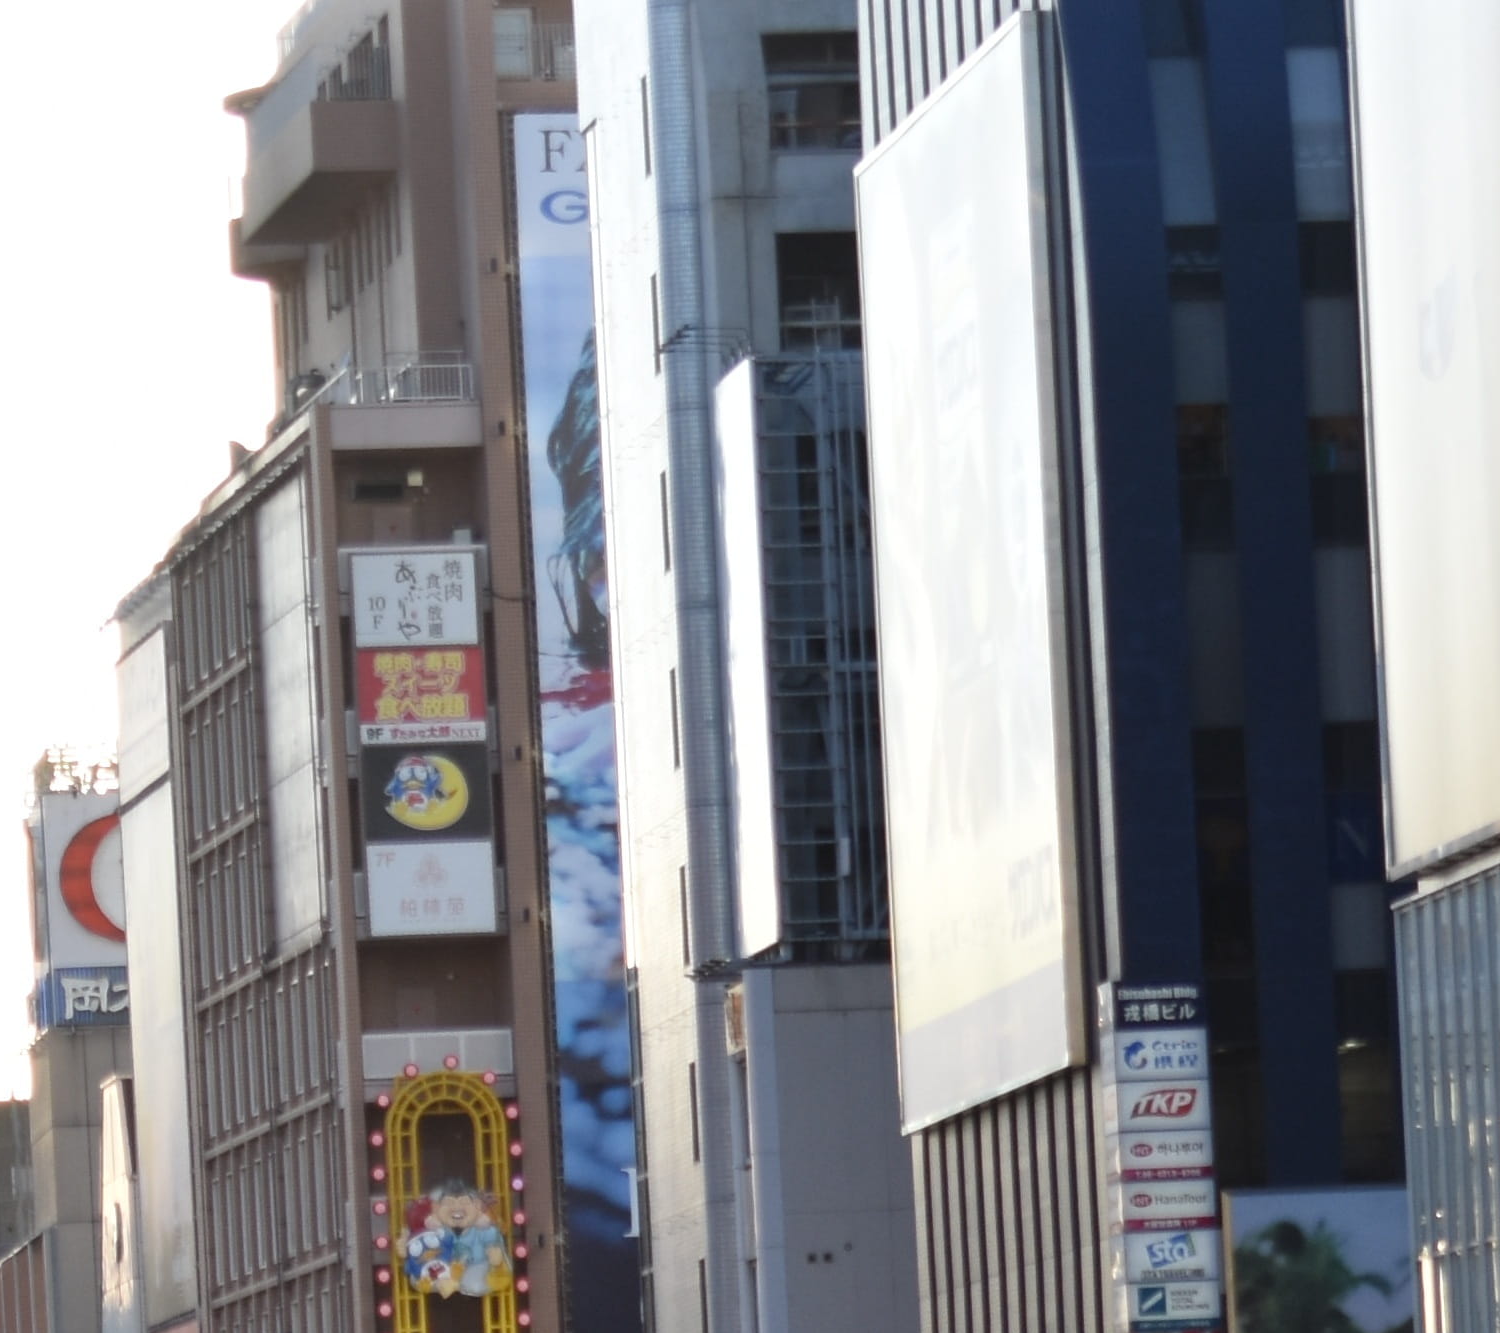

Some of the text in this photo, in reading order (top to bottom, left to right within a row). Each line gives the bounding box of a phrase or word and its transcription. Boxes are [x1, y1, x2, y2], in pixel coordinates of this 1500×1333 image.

[444, 560, 463, 602] 焼肉
[426, 573, 444, 639] 食べ放題
[376, 694, 468, 722] 食べ放題
[1123, 1003, 1196, 1022] 戎橋ビル
[1137, 1092, 1192, 1116] TKP
